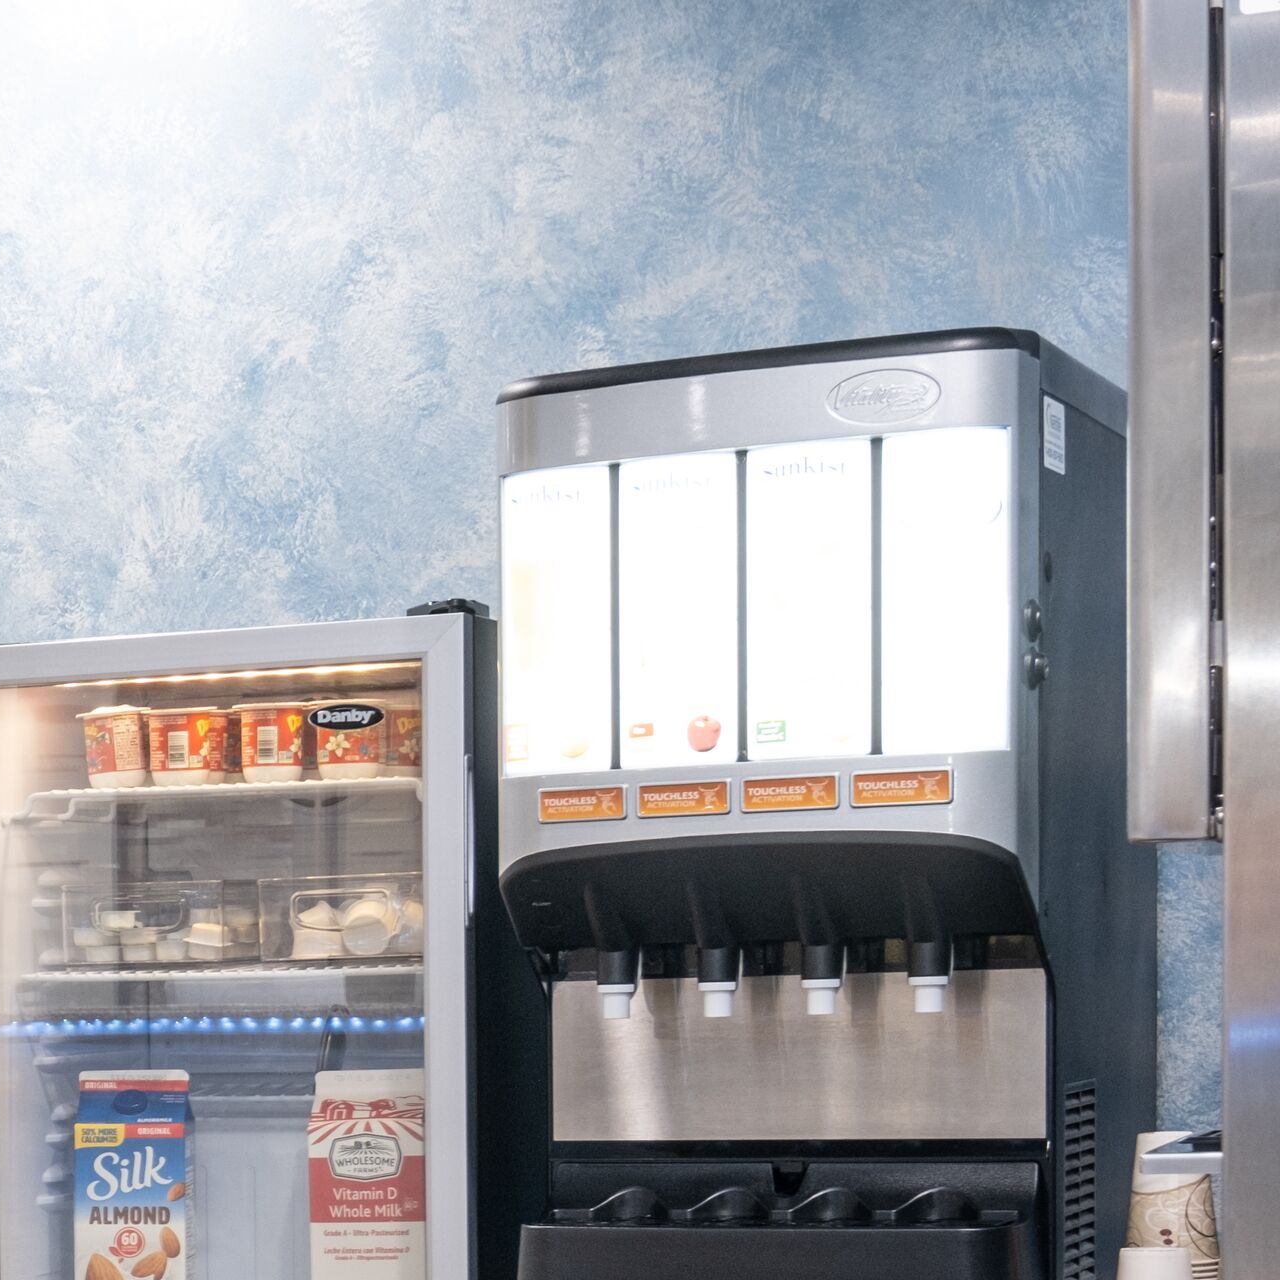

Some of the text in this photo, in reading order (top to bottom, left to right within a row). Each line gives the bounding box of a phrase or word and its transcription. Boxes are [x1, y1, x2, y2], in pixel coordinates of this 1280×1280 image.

[317, 708, 375, 725] Danby
[857, 779, 919, 790] TOUCHLESS
[643, 791, 700, 802] TOUCHLESS
[747, 785, 807, 797] TOUCHLESS
[860, 789, 915, 798] ACTIVATION
[543, 796, 597, 806] TOUCHLESS
[646, 800, 696, 808] ACTIVATION
[751, 794, 803, 804] ACTIVATION
[546, 804, 594, 814] ACTIVATION
[84, 1081, 118, 1089] ORIGINAL
[137, 1127, 172, 1135] ORIGINAL
[335, 1156, 396, 1168] WHOLESOME
[86, 1145, 174, 1201] Silk
[333, 1187, 398, 1201] Vitamin D
[89, 1206, 171, 1225] ALMOND
[329, 1205, 372, 1218] Whole
[374, 1204, 403, 1217] Milk
[120, 1232, 138, 1245] 60
